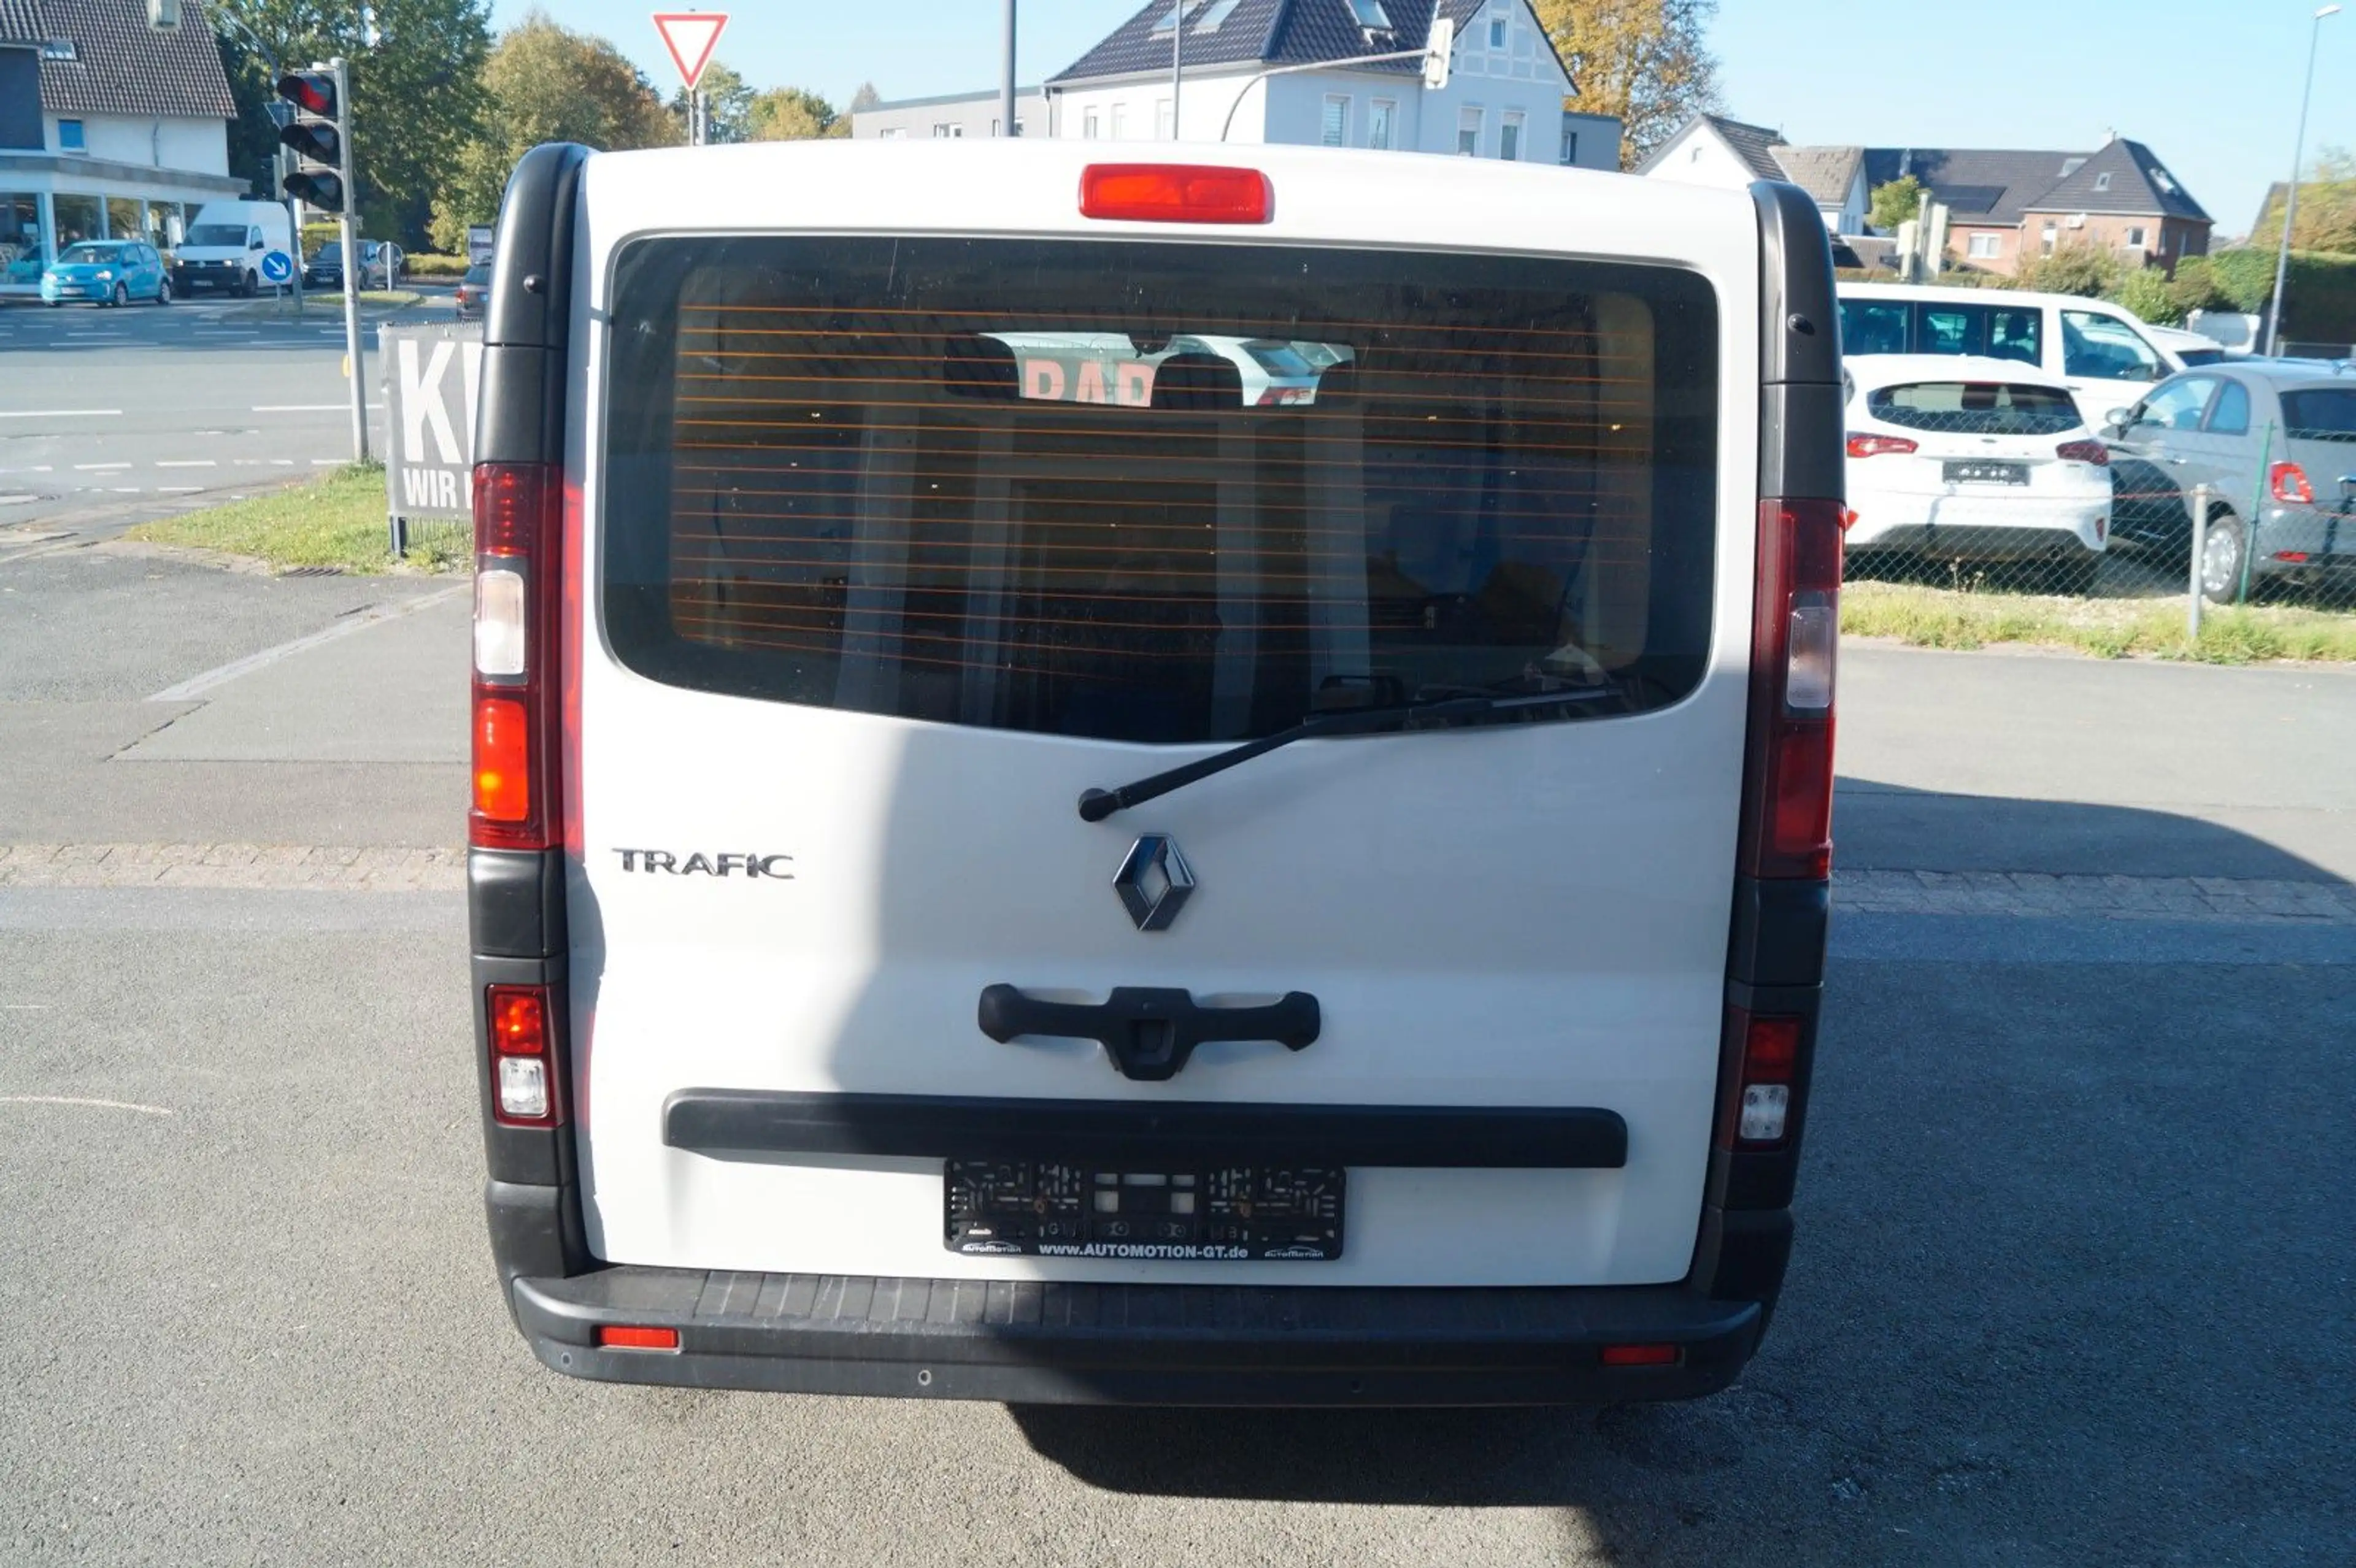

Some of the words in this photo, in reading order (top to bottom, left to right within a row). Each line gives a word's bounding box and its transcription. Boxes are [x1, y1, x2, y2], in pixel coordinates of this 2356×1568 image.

[402, 467, 458, 509] WIR
[612, 847, 795, 880] TRAFIC
[1039, 1243, 1249, 1259] www.AUTOMOTION-GT.de
